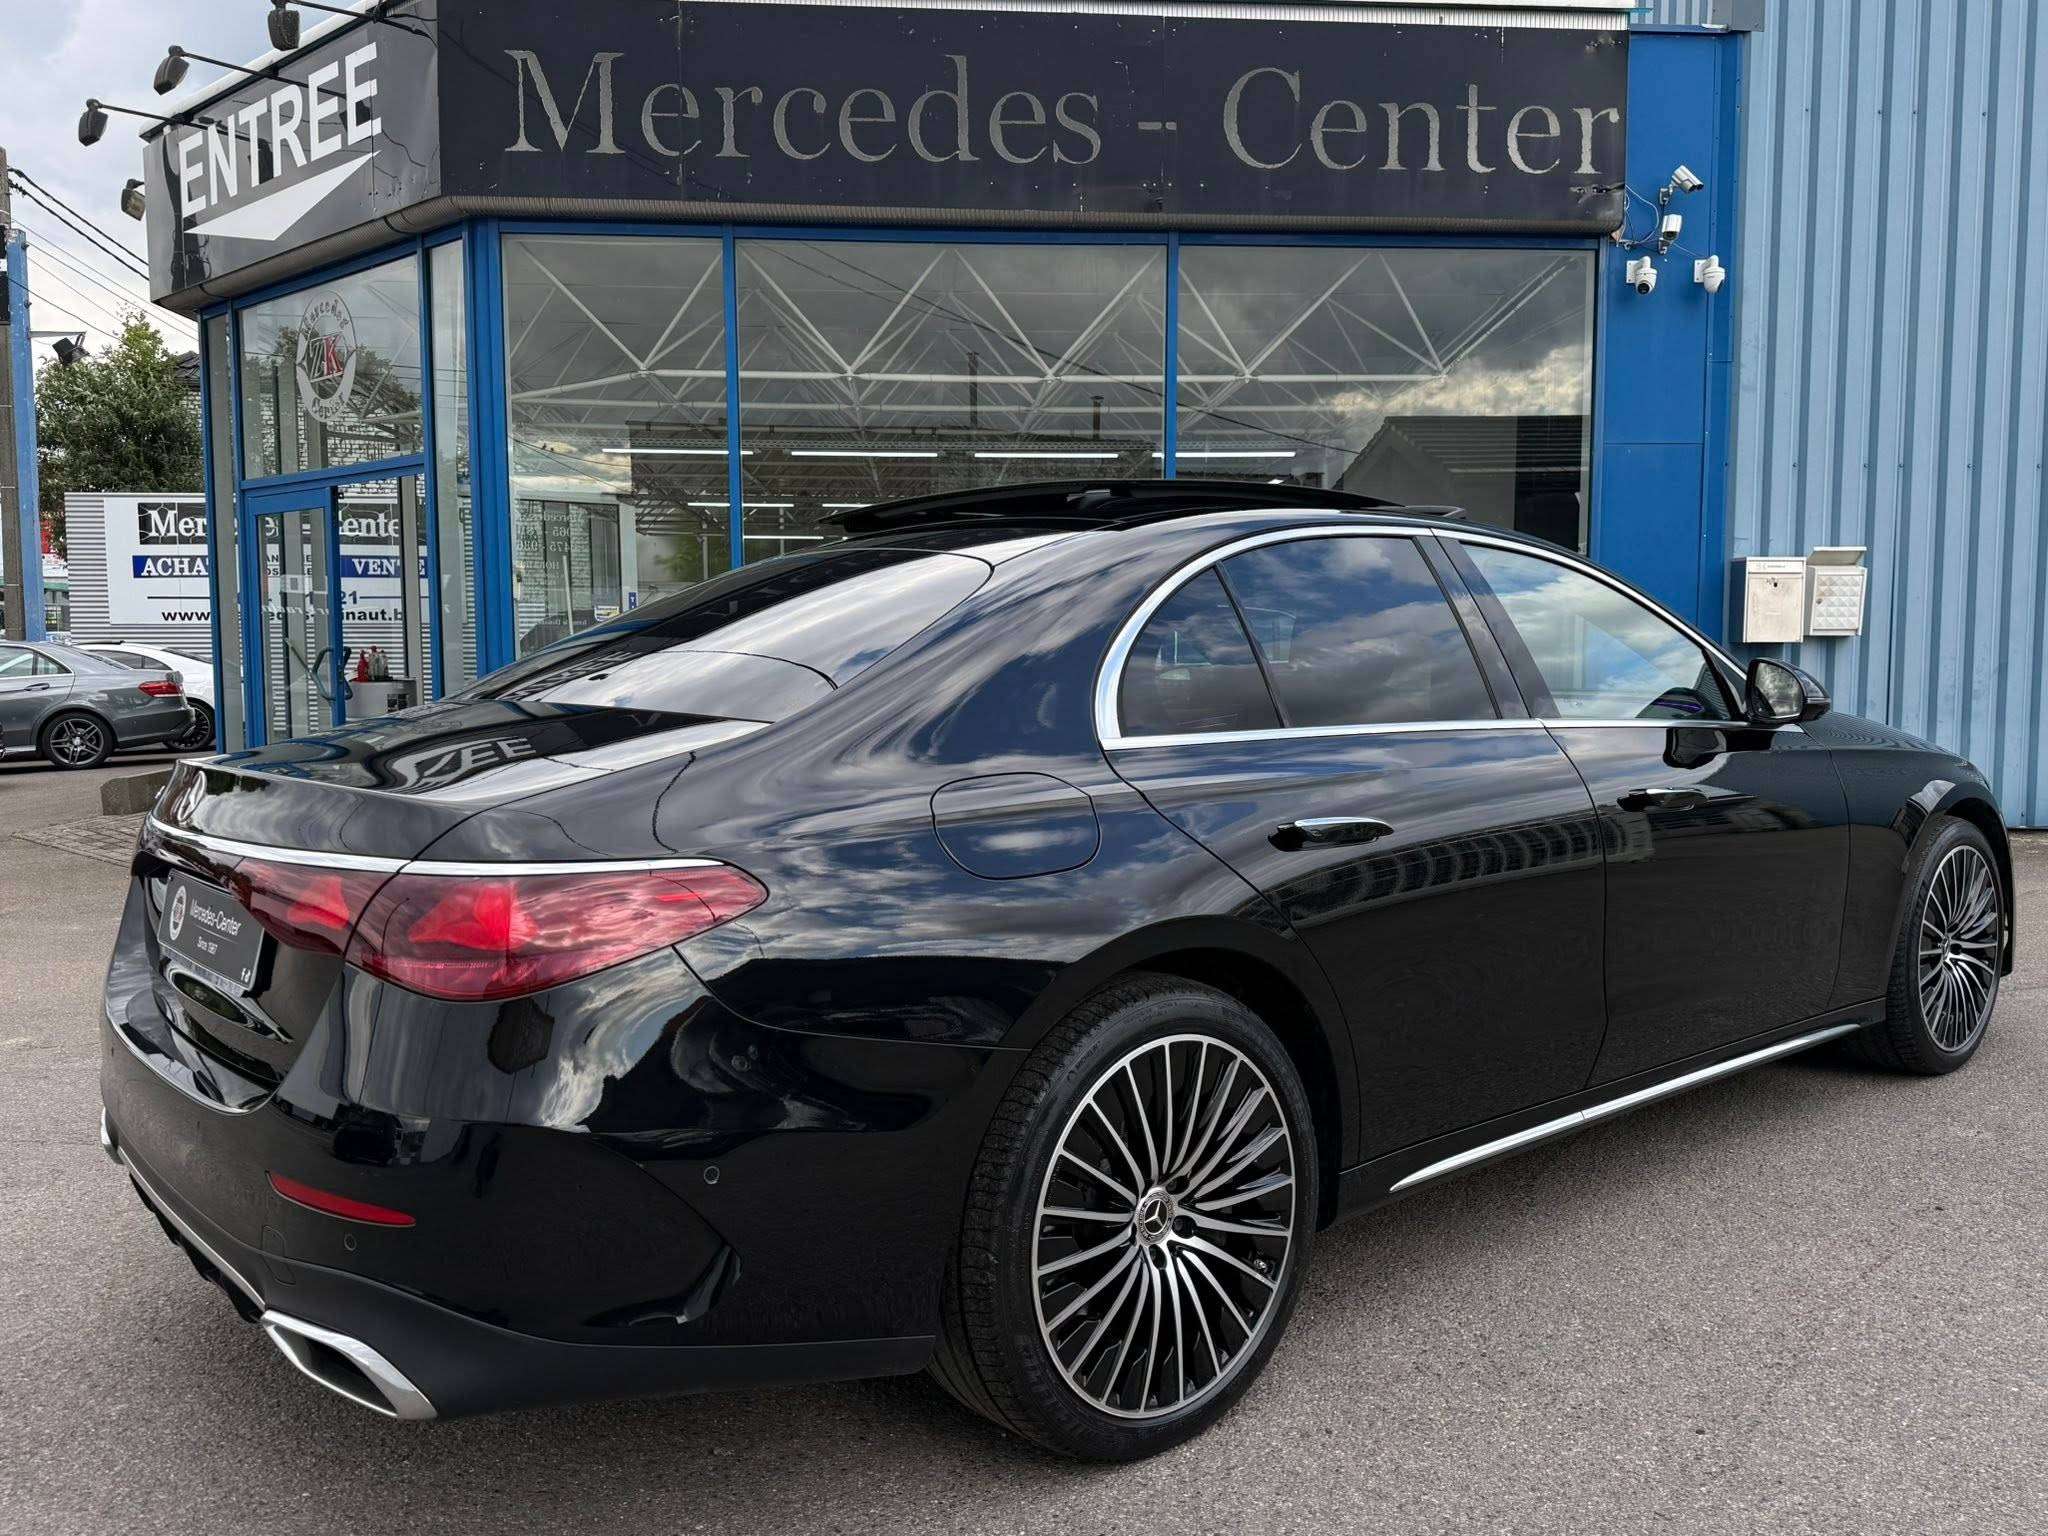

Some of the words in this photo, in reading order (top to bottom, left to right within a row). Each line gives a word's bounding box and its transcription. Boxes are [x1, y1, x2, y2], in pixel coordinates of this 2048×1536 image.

[178, 41, 382, 218] ENTREE
[504, 49, 1101, 165] Mercedes
[1223, 67, 1621, 175] Center
[338, 509, 399, 537] ente
[141, 558, 208, 576] ACHA
[352, 558, 425, 575] VENE
[190, 898, 242, 936] Mercedes-Center
